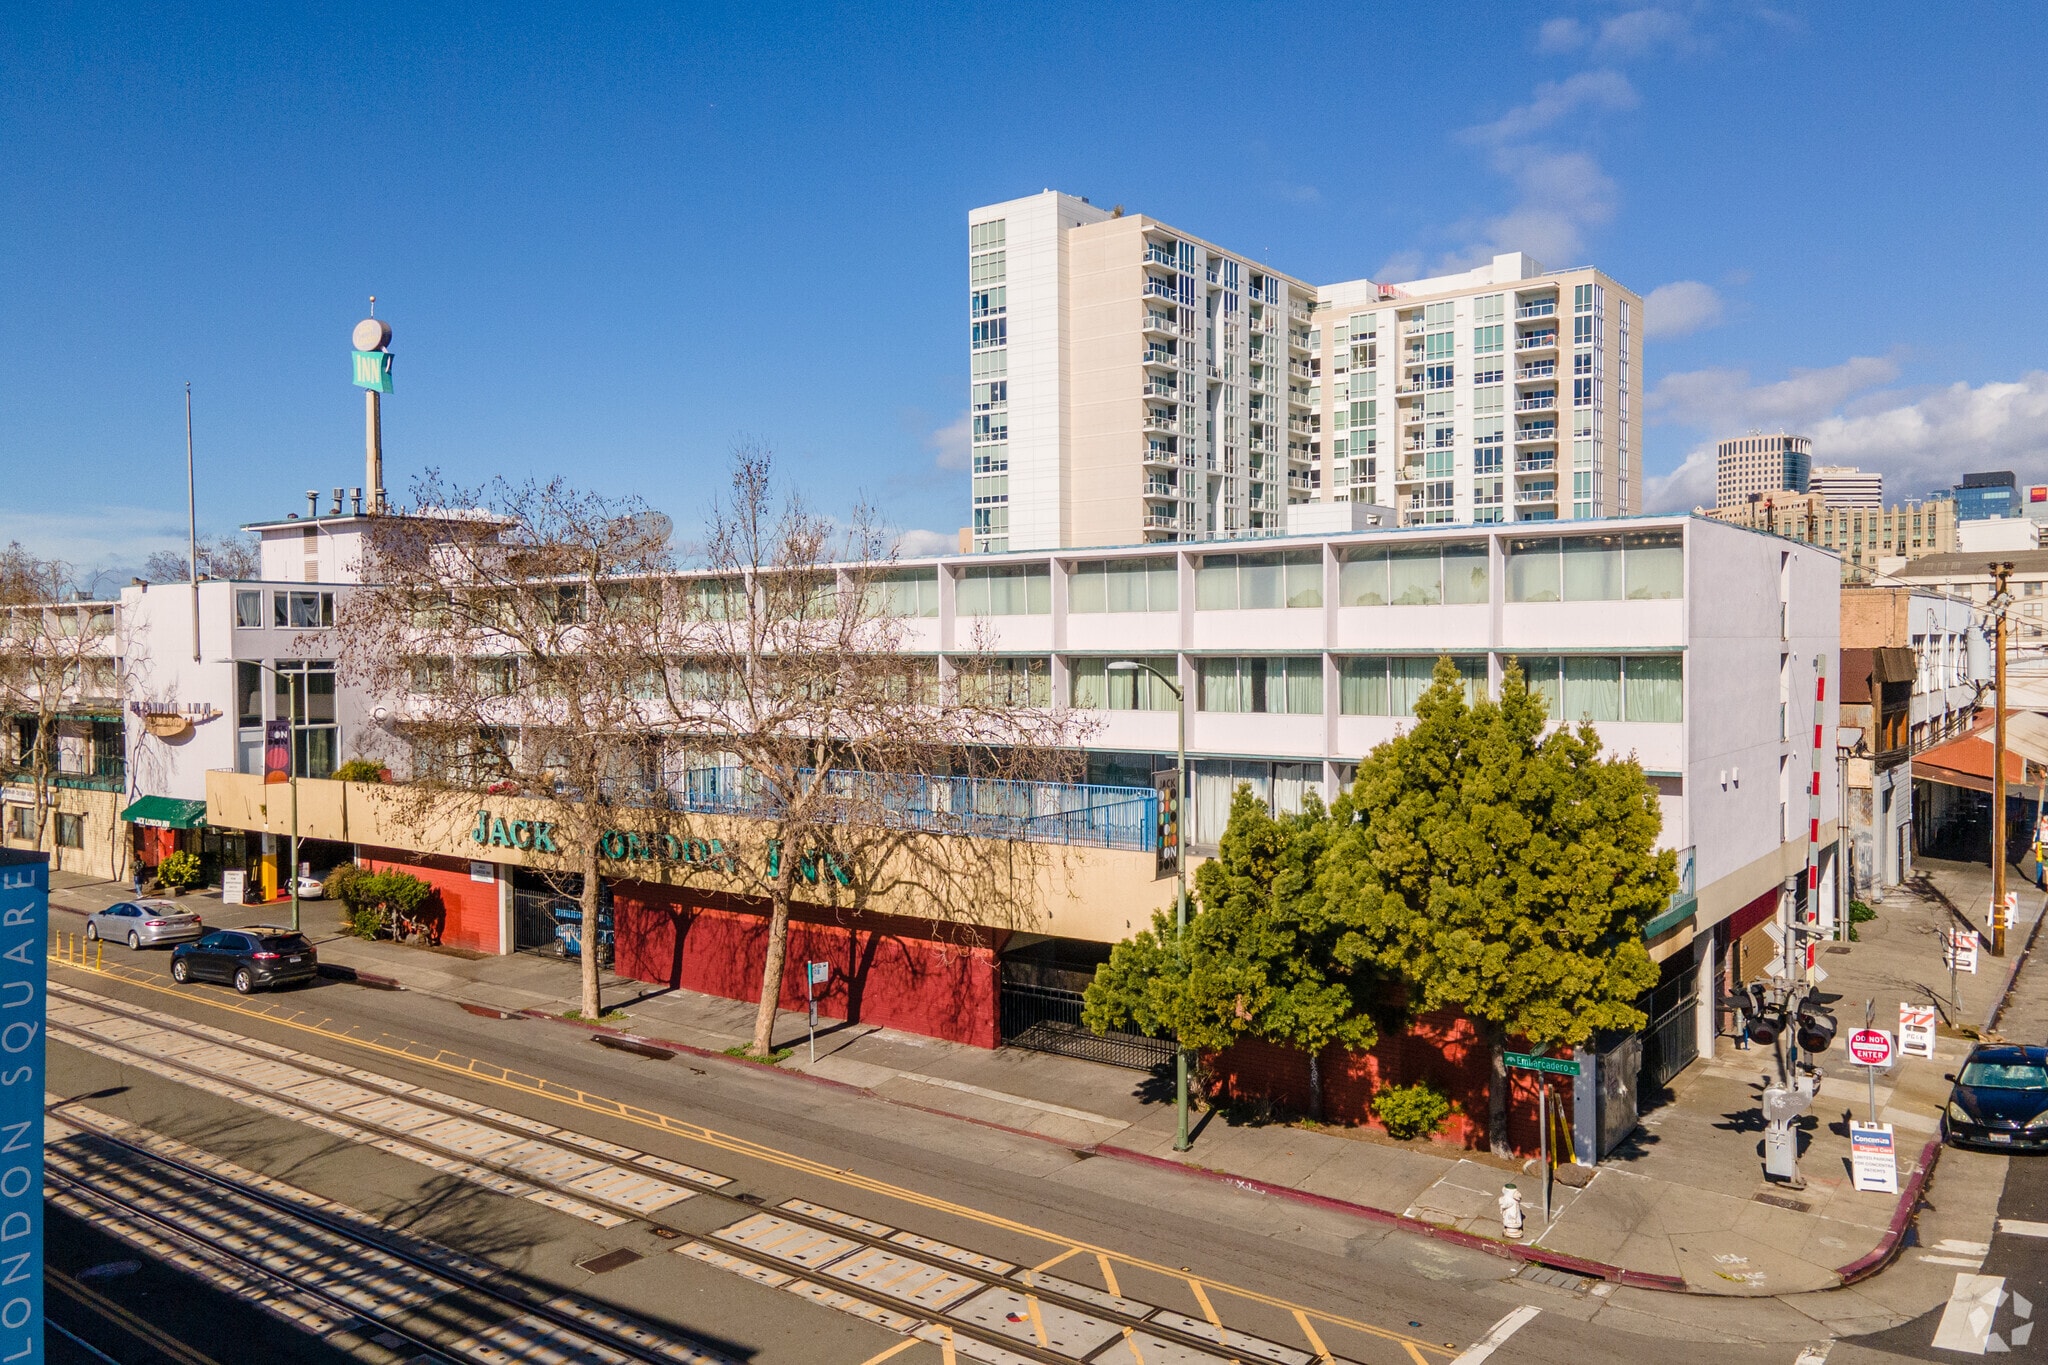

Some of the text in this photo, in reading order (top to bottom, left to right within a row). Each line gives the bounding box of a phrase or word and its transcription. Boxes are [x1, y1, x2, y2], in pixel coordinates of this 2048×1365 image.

[356, 355, 380, 384] INN
[471, 810, 557, 852] JACK
[579, 826, 734, 873] ONDON
[1516, 1056, 1569, 1072] Embarcadero
[1857, 1050, 1884, 1059] ENTER
[1, 869, 39, 1363] LONDON SQUARE
[1853, 1135, 1890, 1145] Concentra
